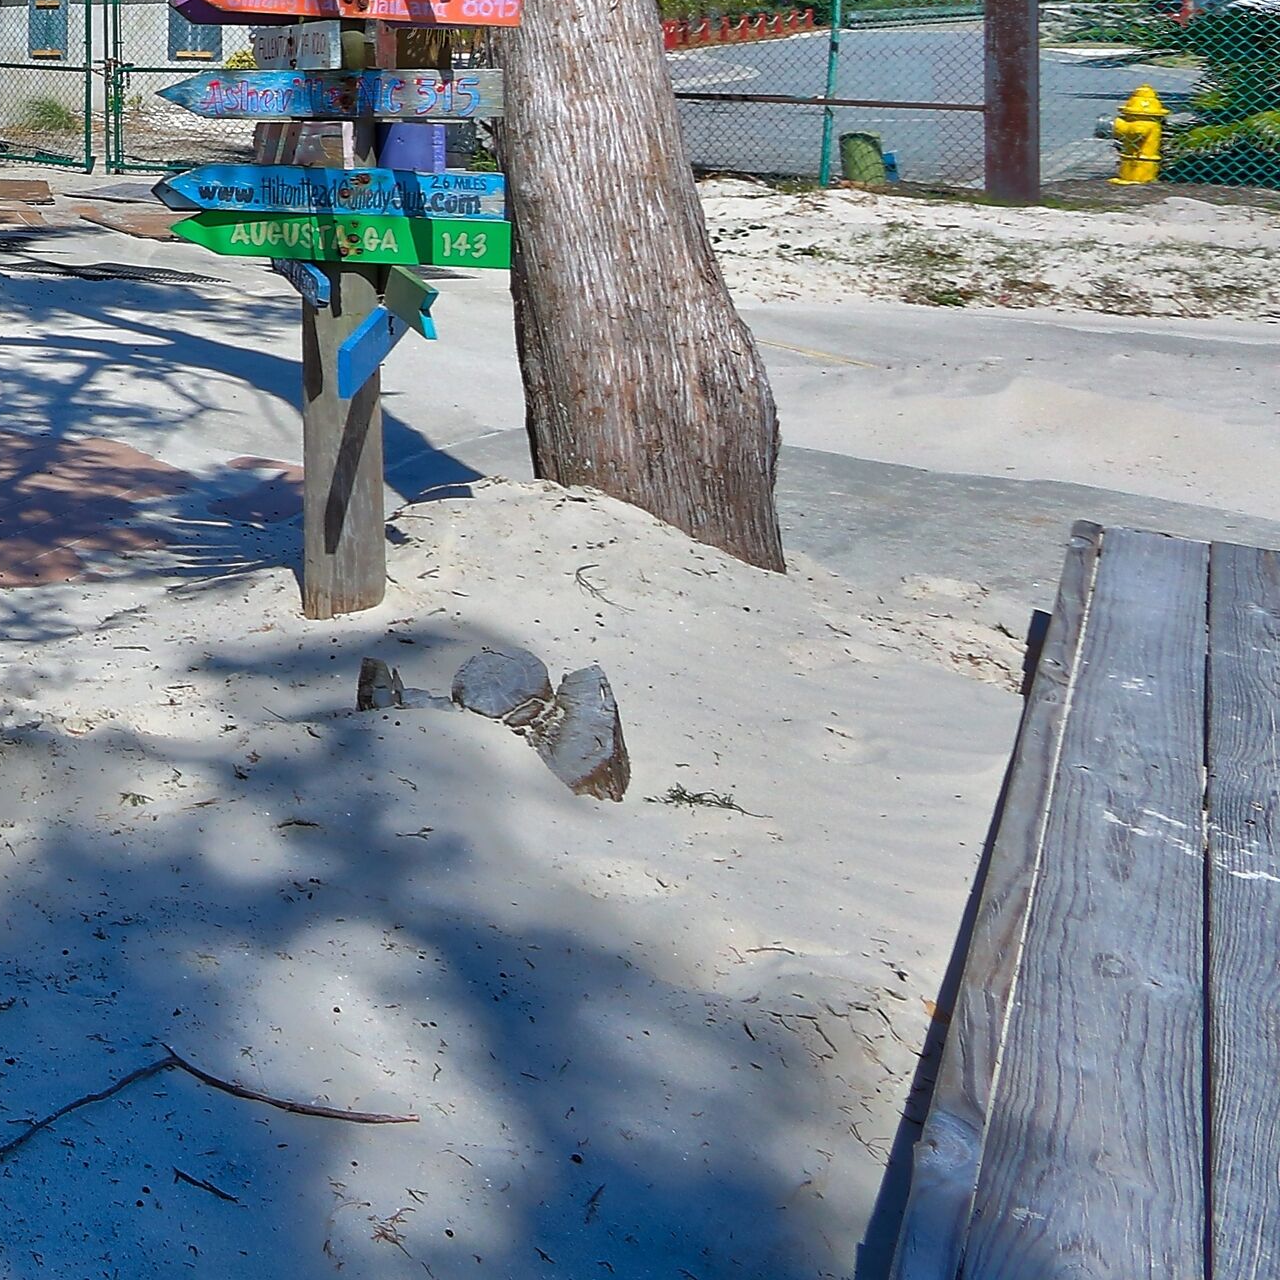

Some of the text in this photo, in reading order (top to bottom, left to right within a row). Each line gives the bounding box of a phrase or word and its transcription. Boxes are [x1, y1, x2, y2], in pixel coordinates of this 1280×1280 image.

[356, 77, 406, 115] NC
[453, 176, 487, 191] MILES
[362, 226, 399, 254] GA
[440, 230, 489, 259] 143
